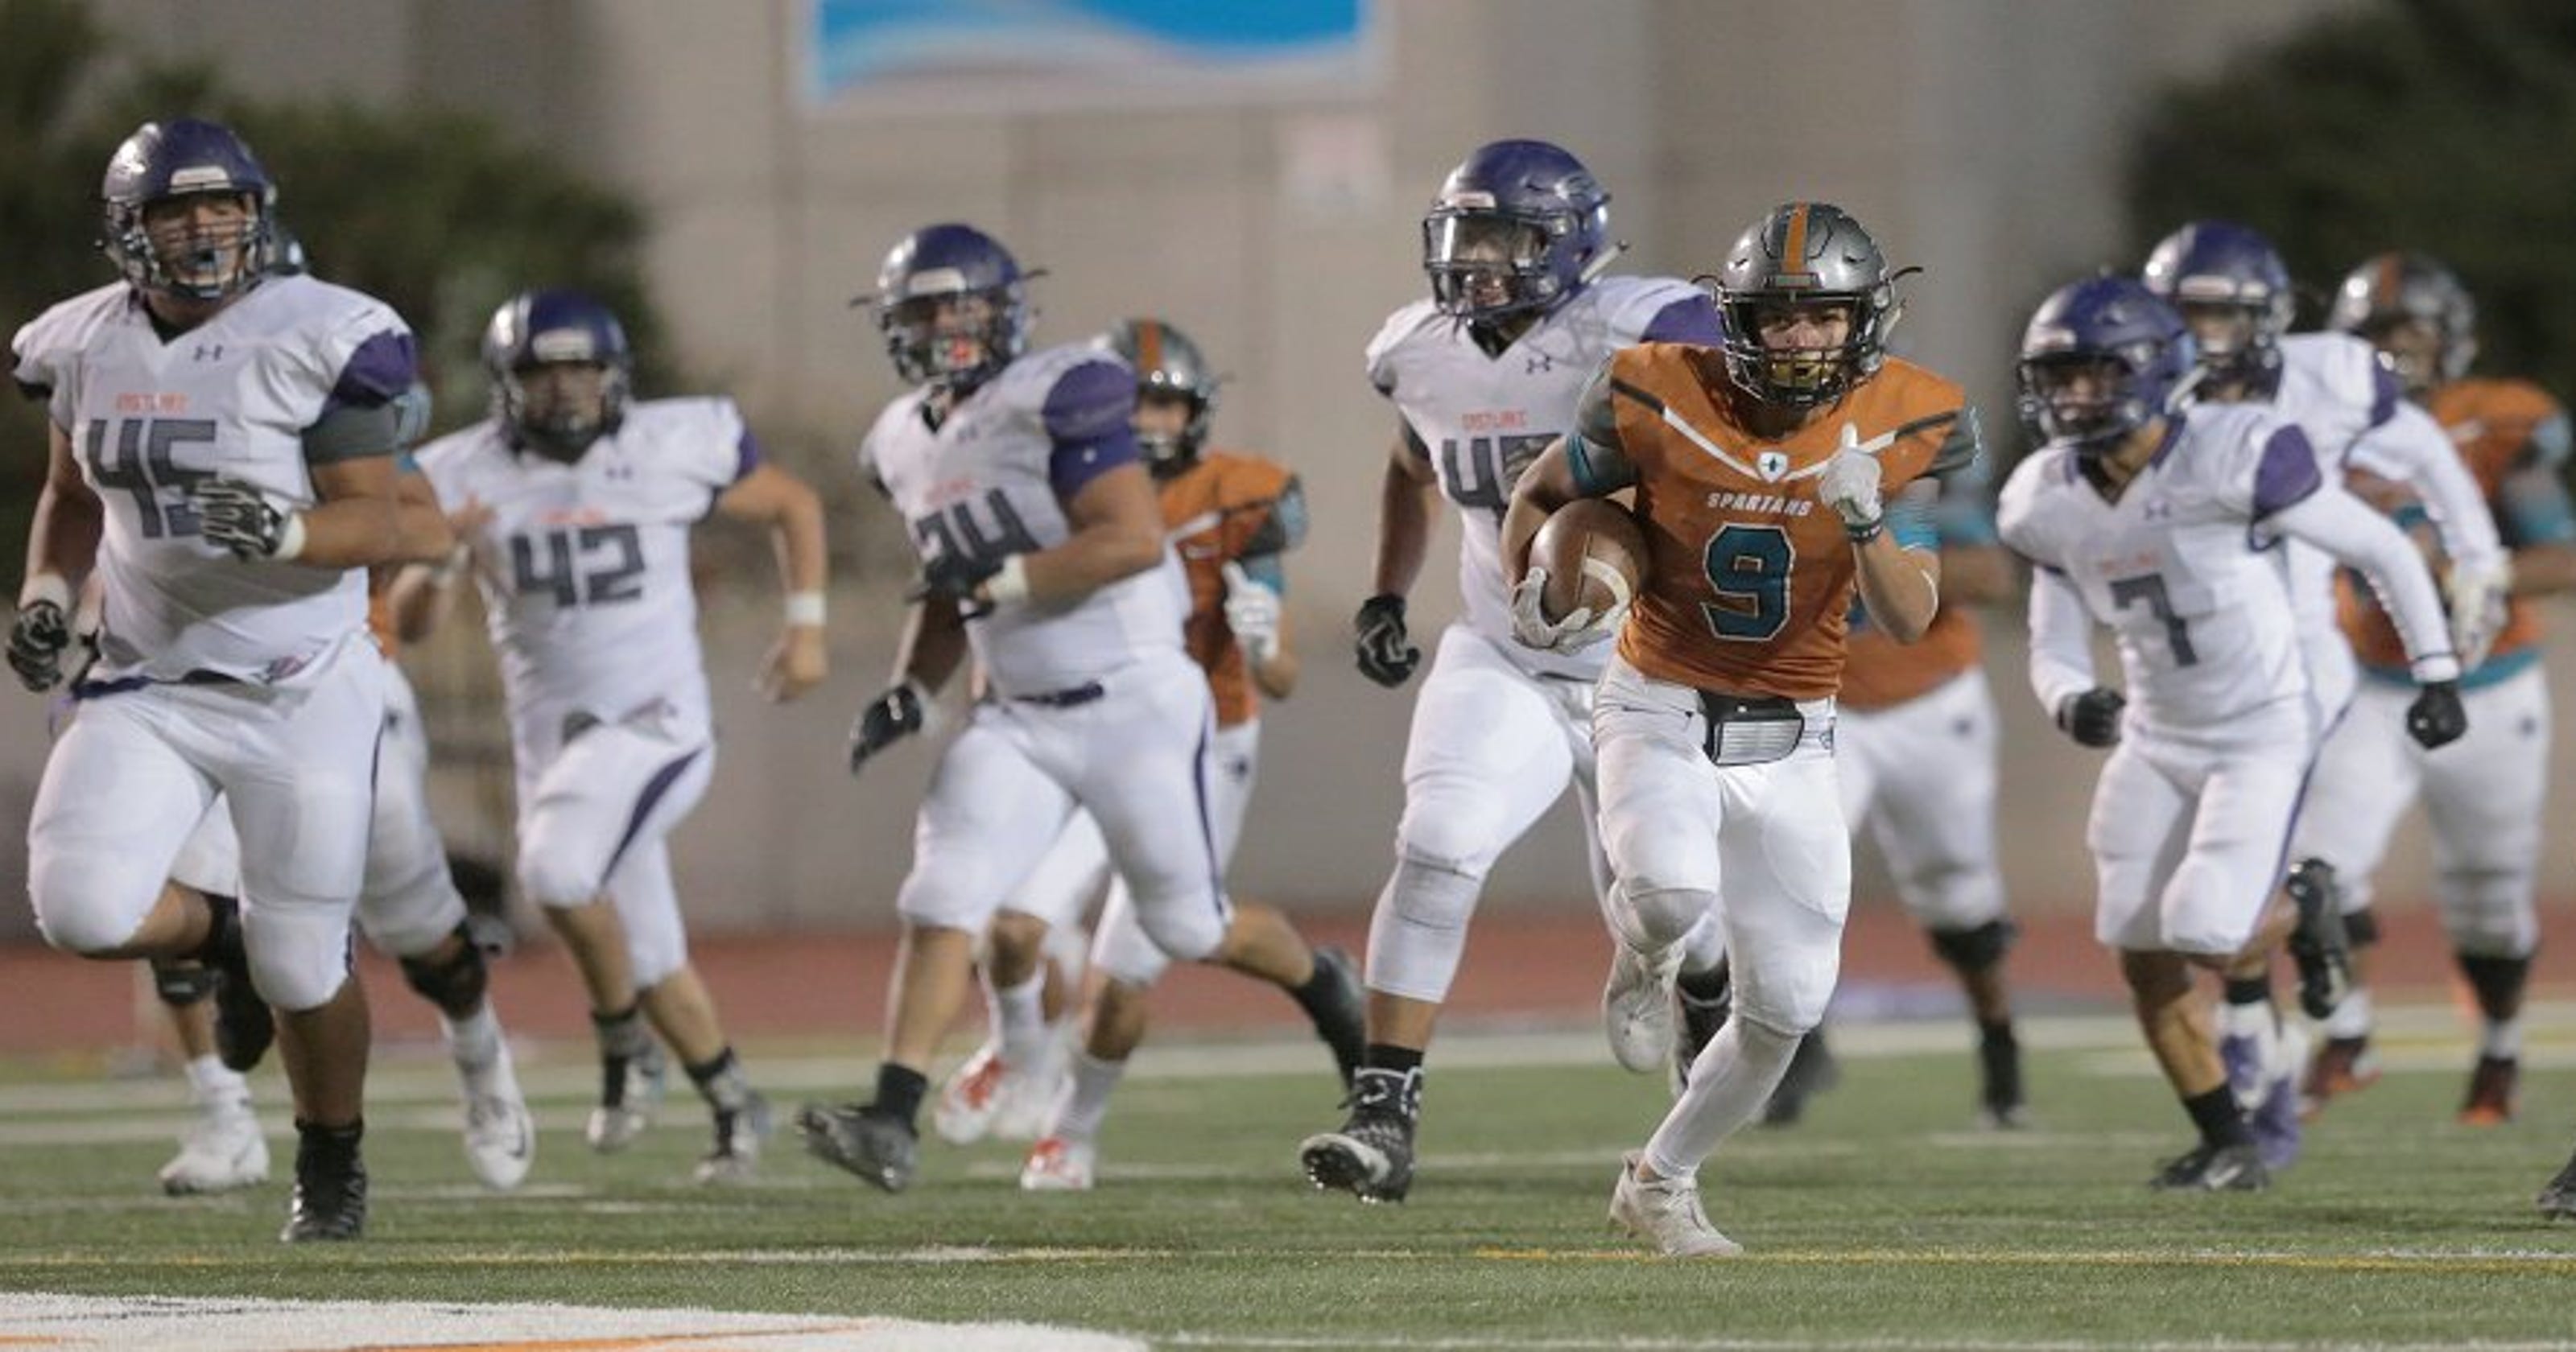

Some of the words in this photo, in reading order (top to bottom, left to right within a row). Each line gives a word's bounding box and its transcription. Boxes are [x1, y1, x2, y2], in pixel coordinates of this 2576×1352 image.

[87, 418, 216, 538] 45
[1707, 492, 1813, 517] SPARTANS
[510, 525, 646, 608] 42
[1699, 521, 1796, 641] 9
[2109, 572, 2198, 667] 7
